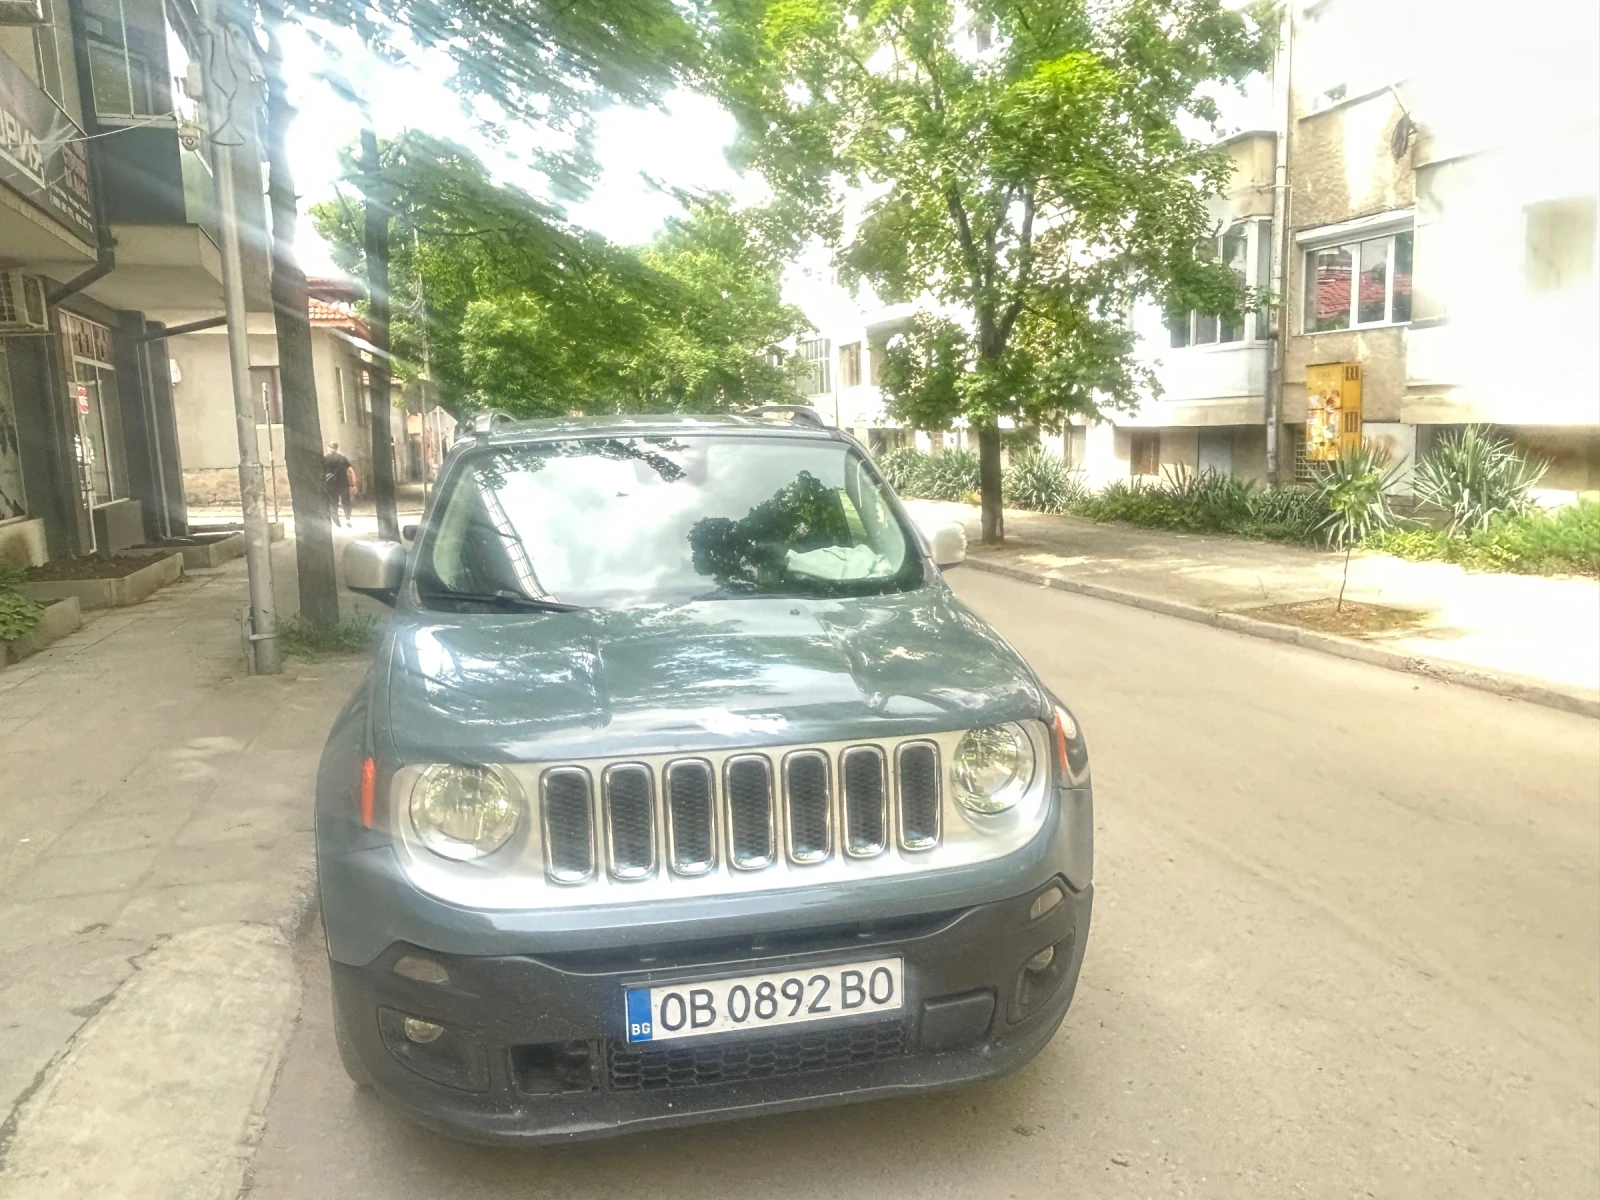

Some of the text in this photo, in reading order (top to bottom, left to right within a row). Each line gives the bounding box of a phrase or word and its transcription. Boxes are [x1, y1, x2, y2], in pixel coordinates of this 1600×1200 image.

[660, 966, 894, 1031] OB 0892 BO
[631, 1022, 651, 1036] BG
